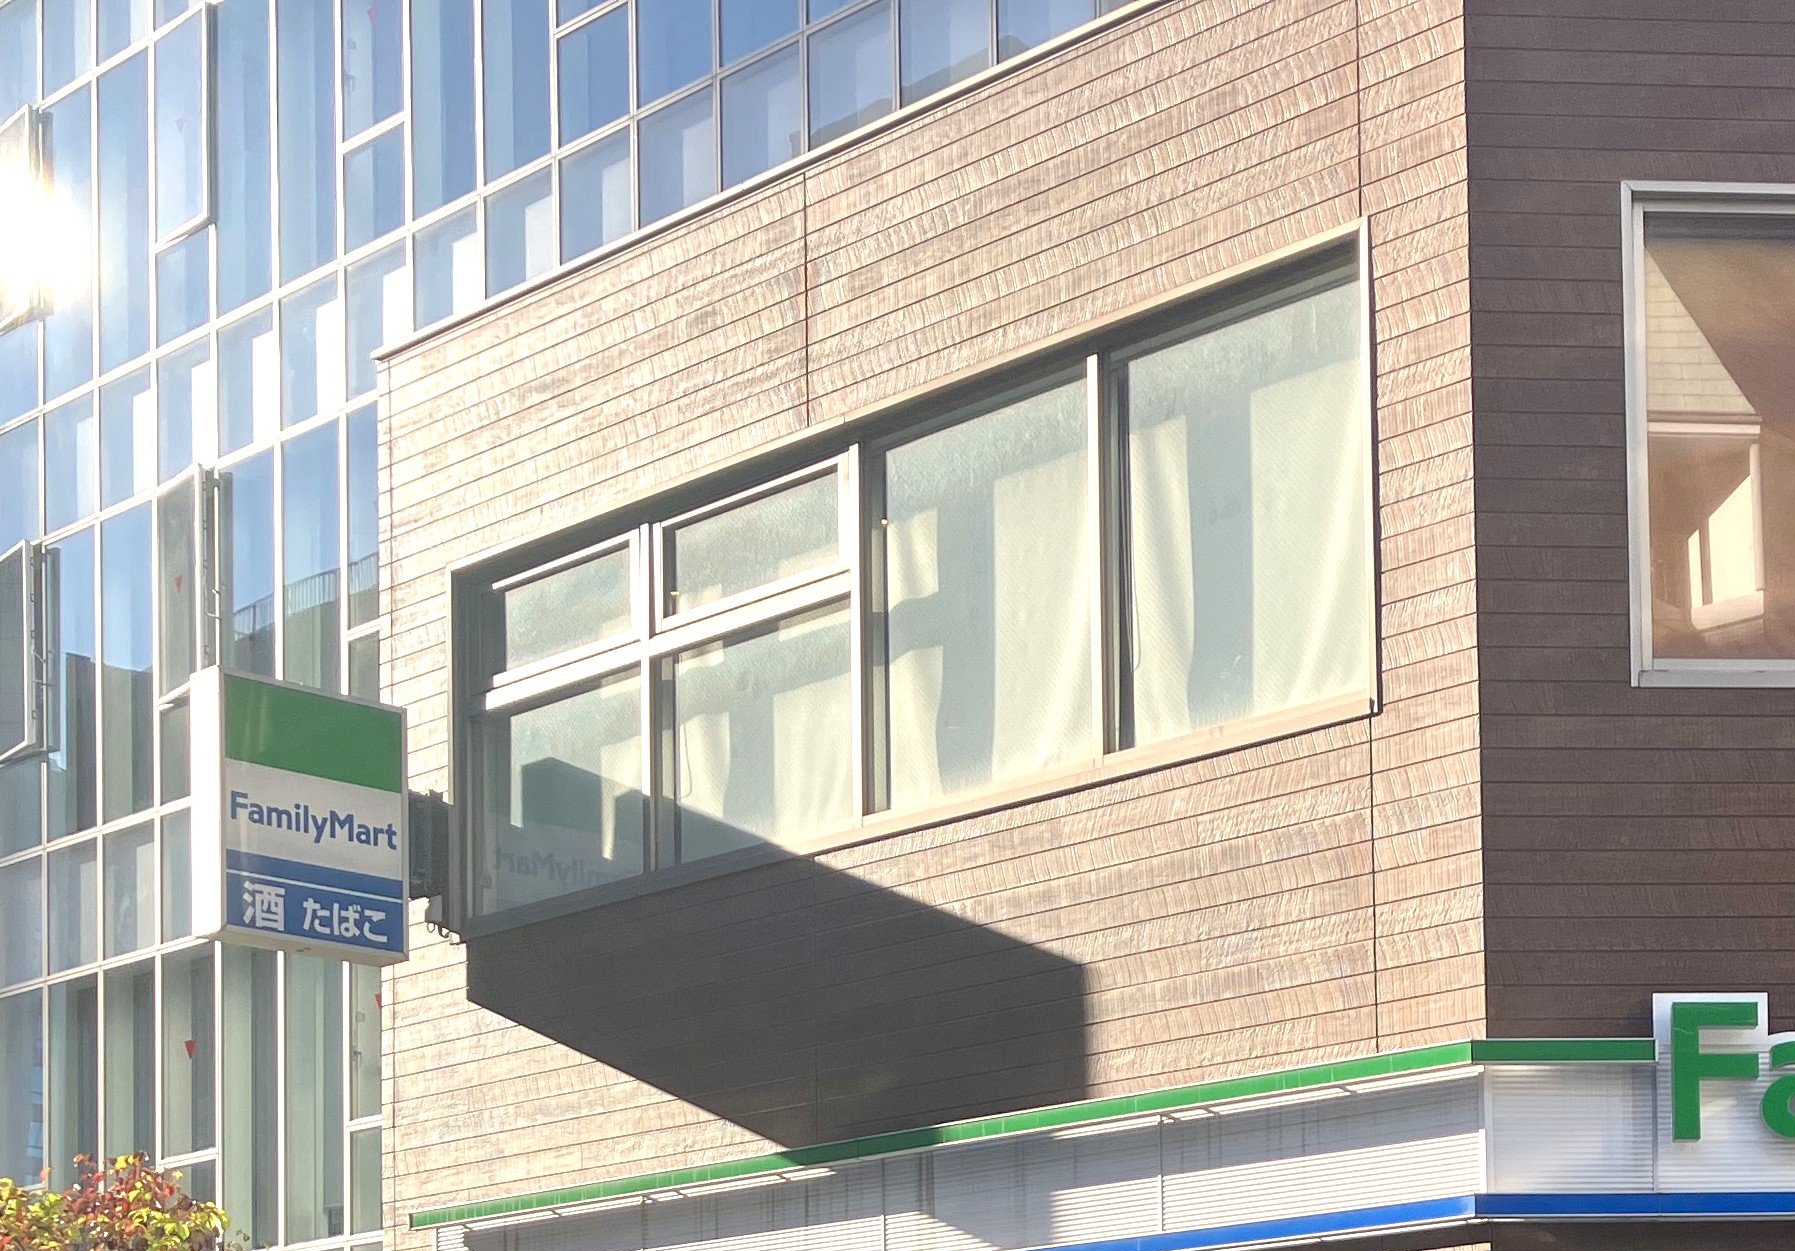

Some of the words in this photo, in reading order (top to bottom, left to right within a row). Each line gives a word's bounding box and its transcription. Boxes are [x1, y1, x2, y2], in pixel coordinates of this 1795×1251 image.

[230, 790, 398, 850] FamilyMart
[242, 880, 285, 931] 酒
[302, 897, 388, 943] たばこ
